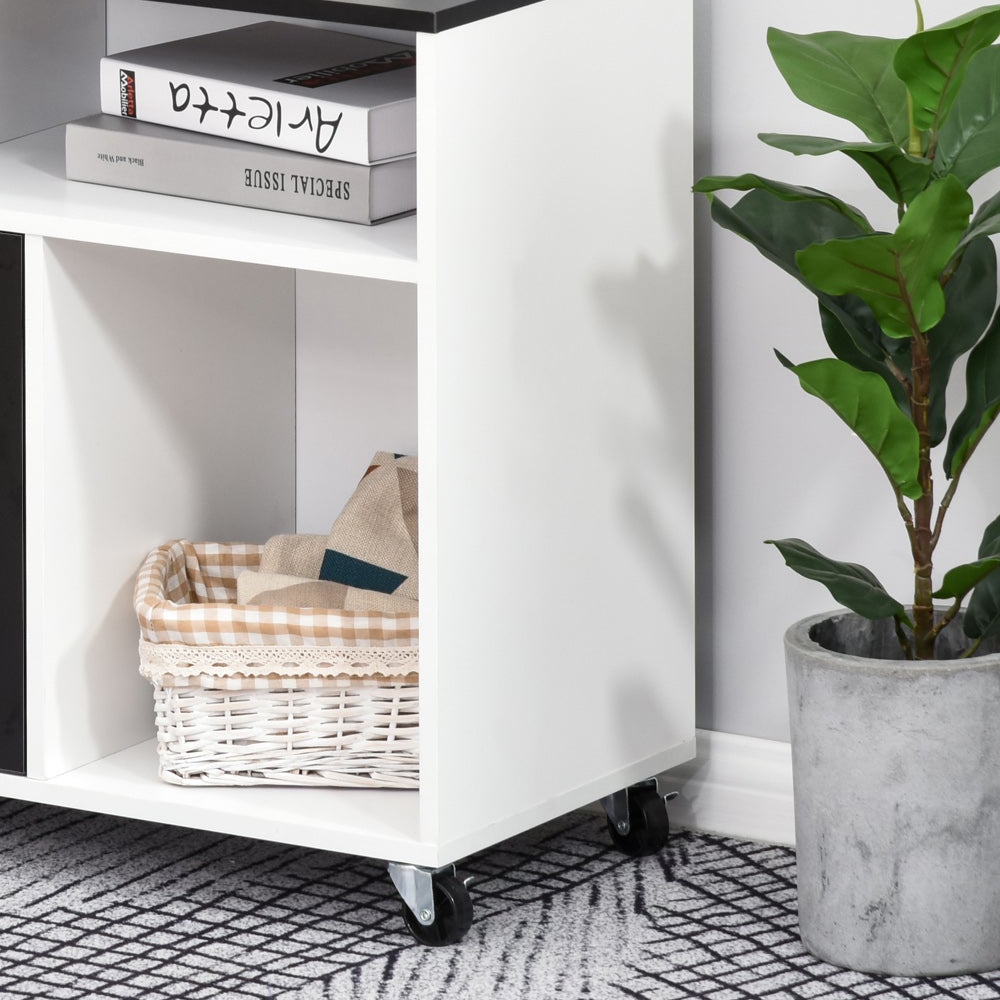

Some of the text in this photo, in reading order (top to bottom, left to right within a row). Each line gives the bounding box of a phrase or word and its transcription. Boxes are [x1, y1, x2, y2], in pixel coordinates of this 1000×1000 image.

[120, 70, 128, 116] Mobilier
[169, 81, 343, 153] Arletta
[97, 152, 145, 167] Black and White
[244, 168, 350, 200] SPECIAL ISSUE
